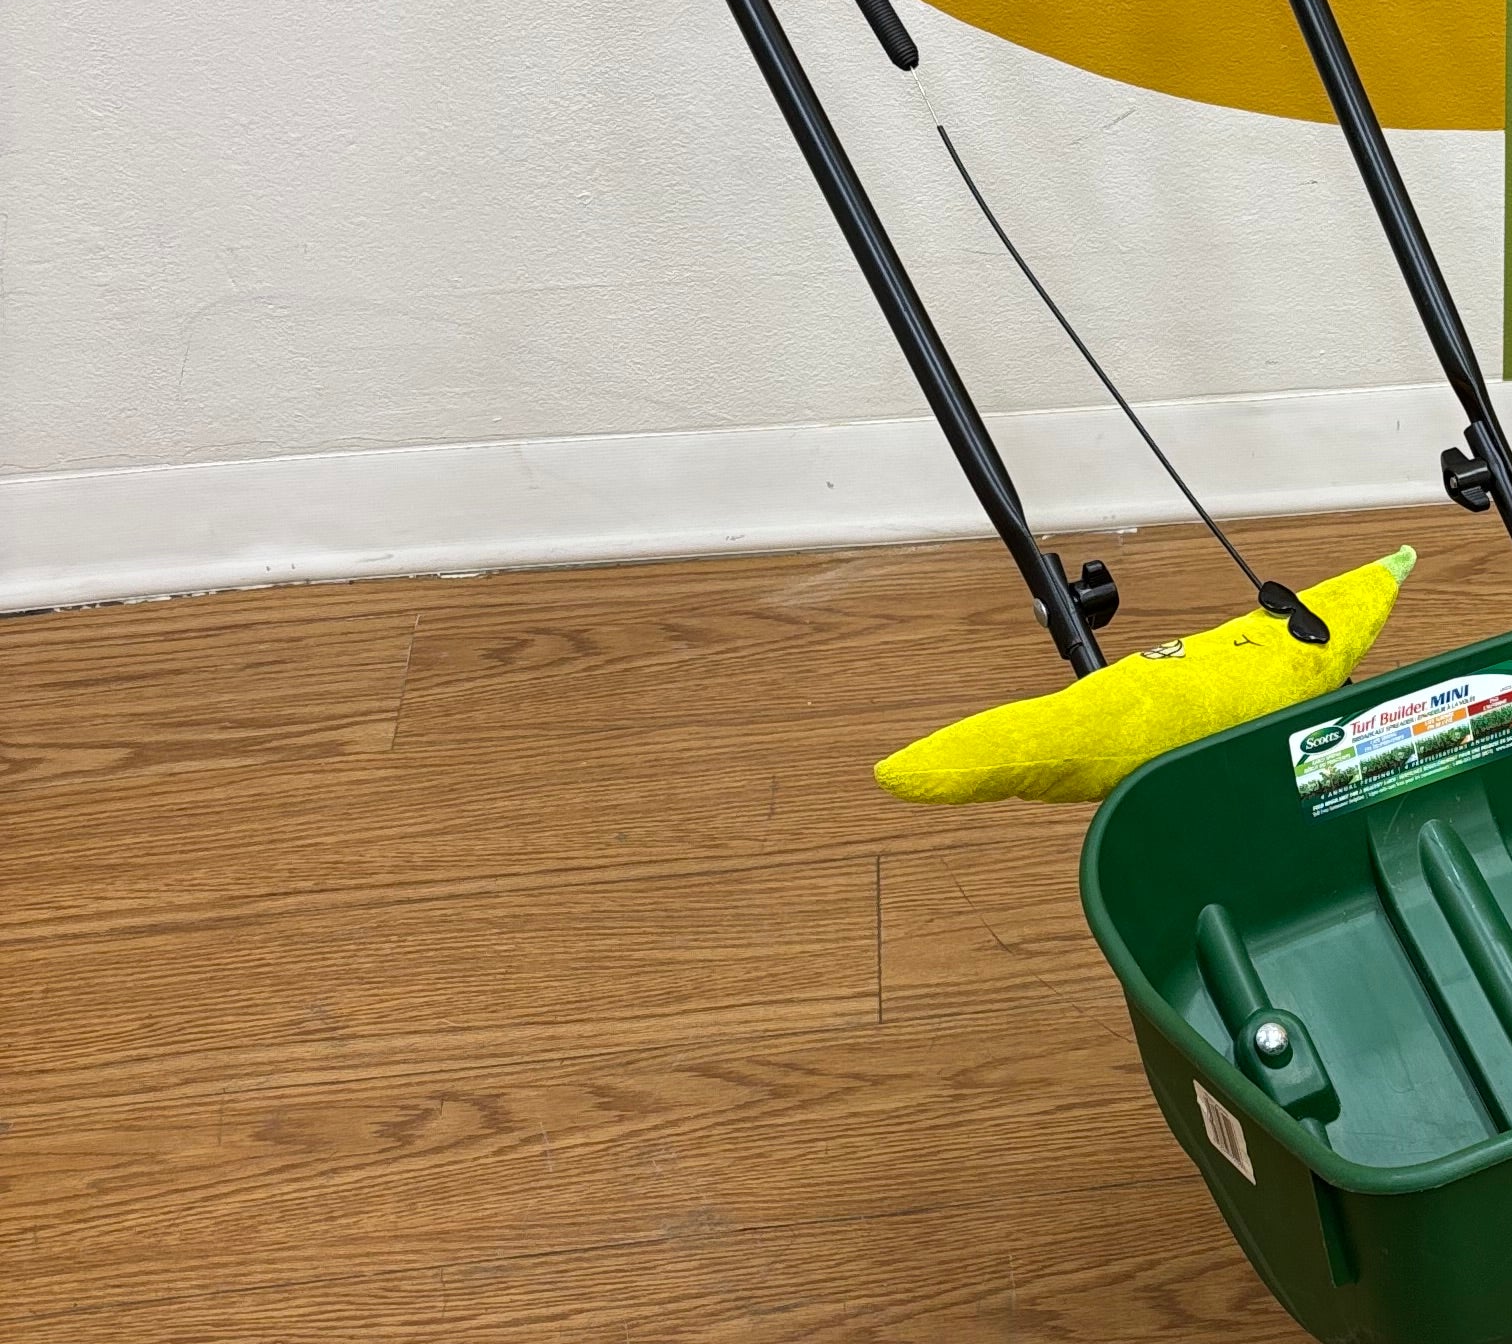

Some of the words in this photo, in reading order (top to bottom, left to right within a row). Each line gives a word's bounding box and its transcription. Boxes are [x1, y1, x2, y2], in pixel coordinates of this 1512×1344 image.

[1350, 714, 1377, 736] Turf
[1379, 700, 1428, 725] Builder
[1429, 683, 1470, 709] MINI
[1305, 729, 1341, 751] Scotts
